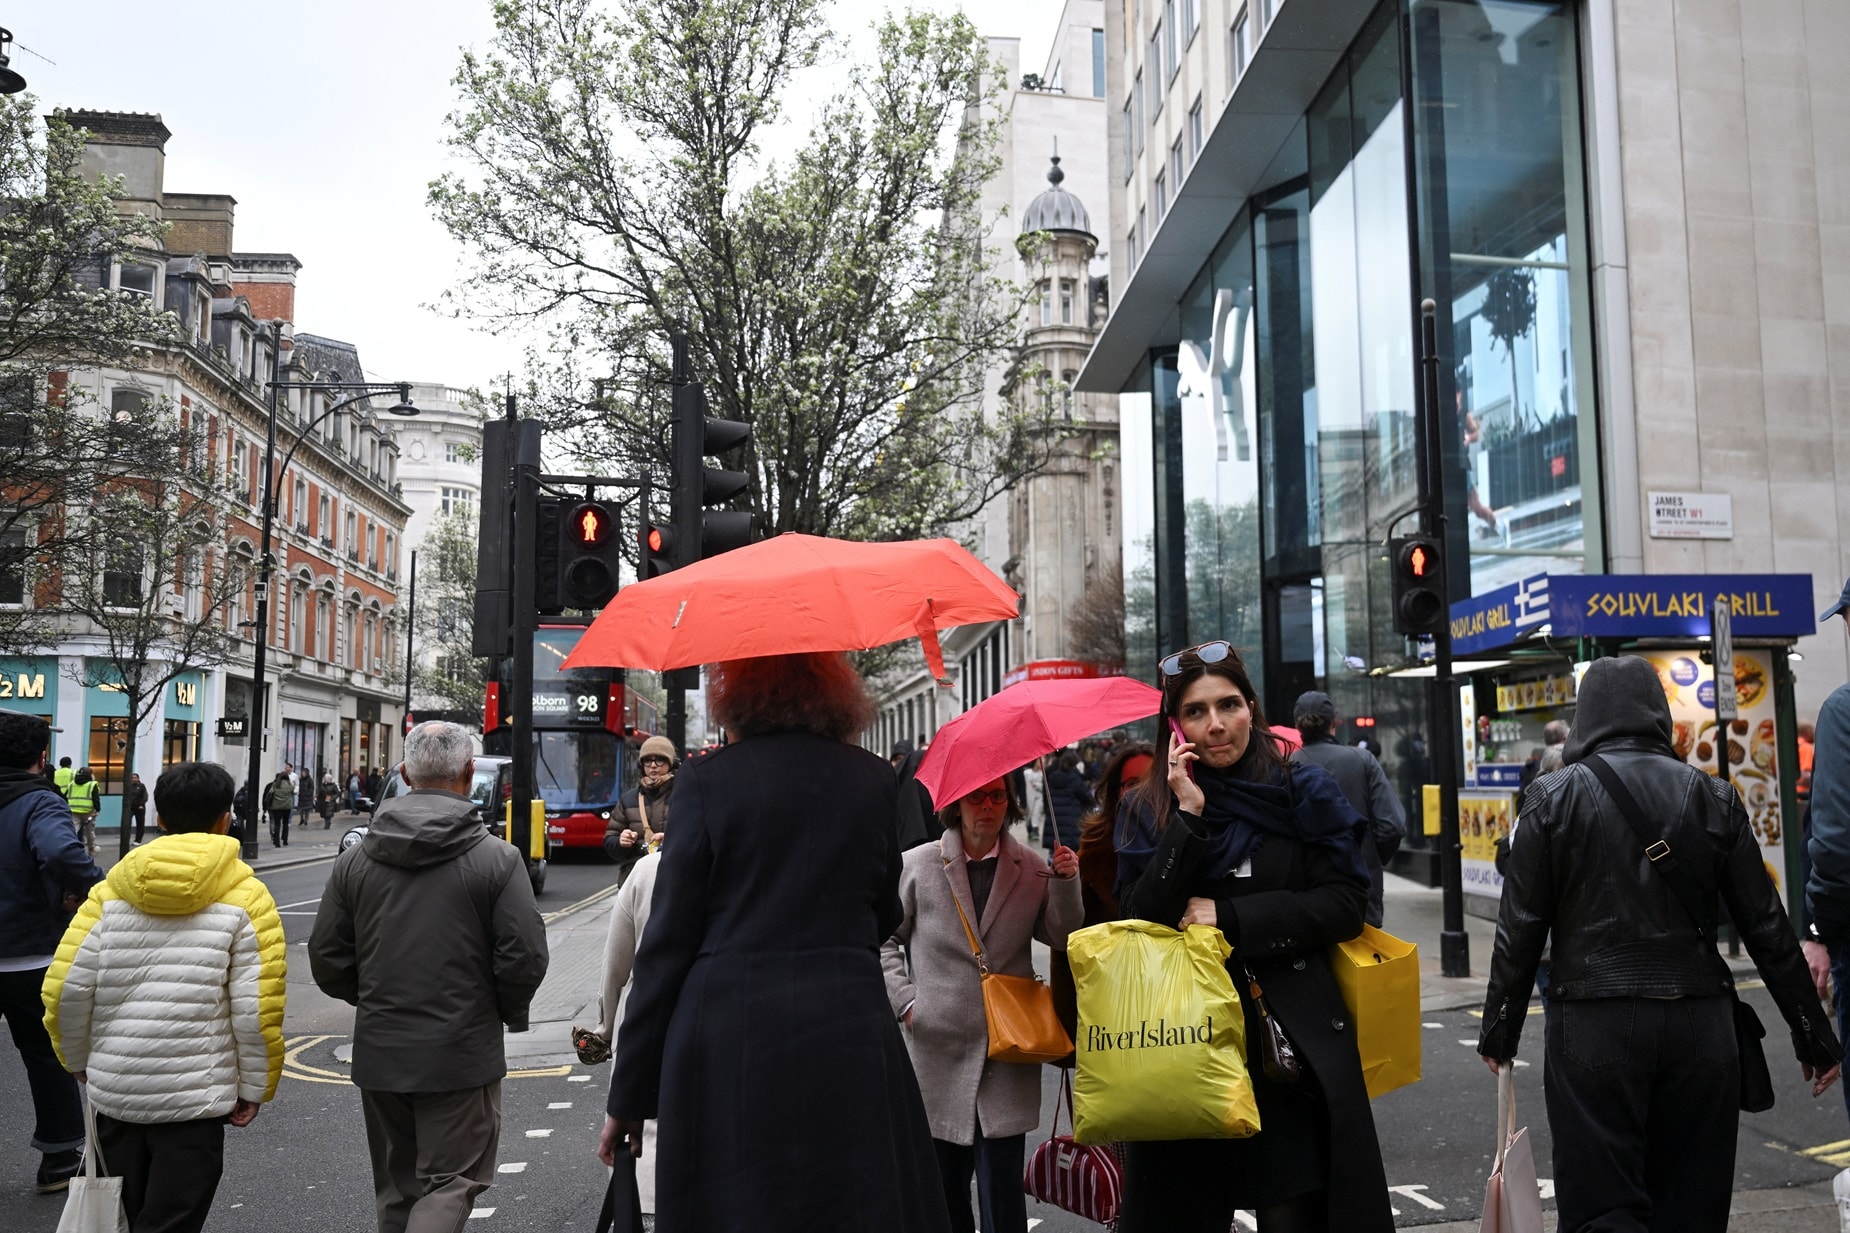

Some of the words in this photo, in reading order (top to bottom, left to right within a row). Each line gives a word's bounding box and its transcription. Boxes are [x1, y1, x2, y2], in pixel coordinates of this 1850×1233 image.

[1655, 496, 1683, 506] JAMES
[1690, 508, 1702, 518] W1
[1586, 592, 1704, 617] SOUVLAKI
[1449, 611, 1485, 640] OUVLAKI
[1487, 603, 1511, 630] GRILL
[532, 695, 566, 705] olborn
[577, 695, 598, 712] 98
